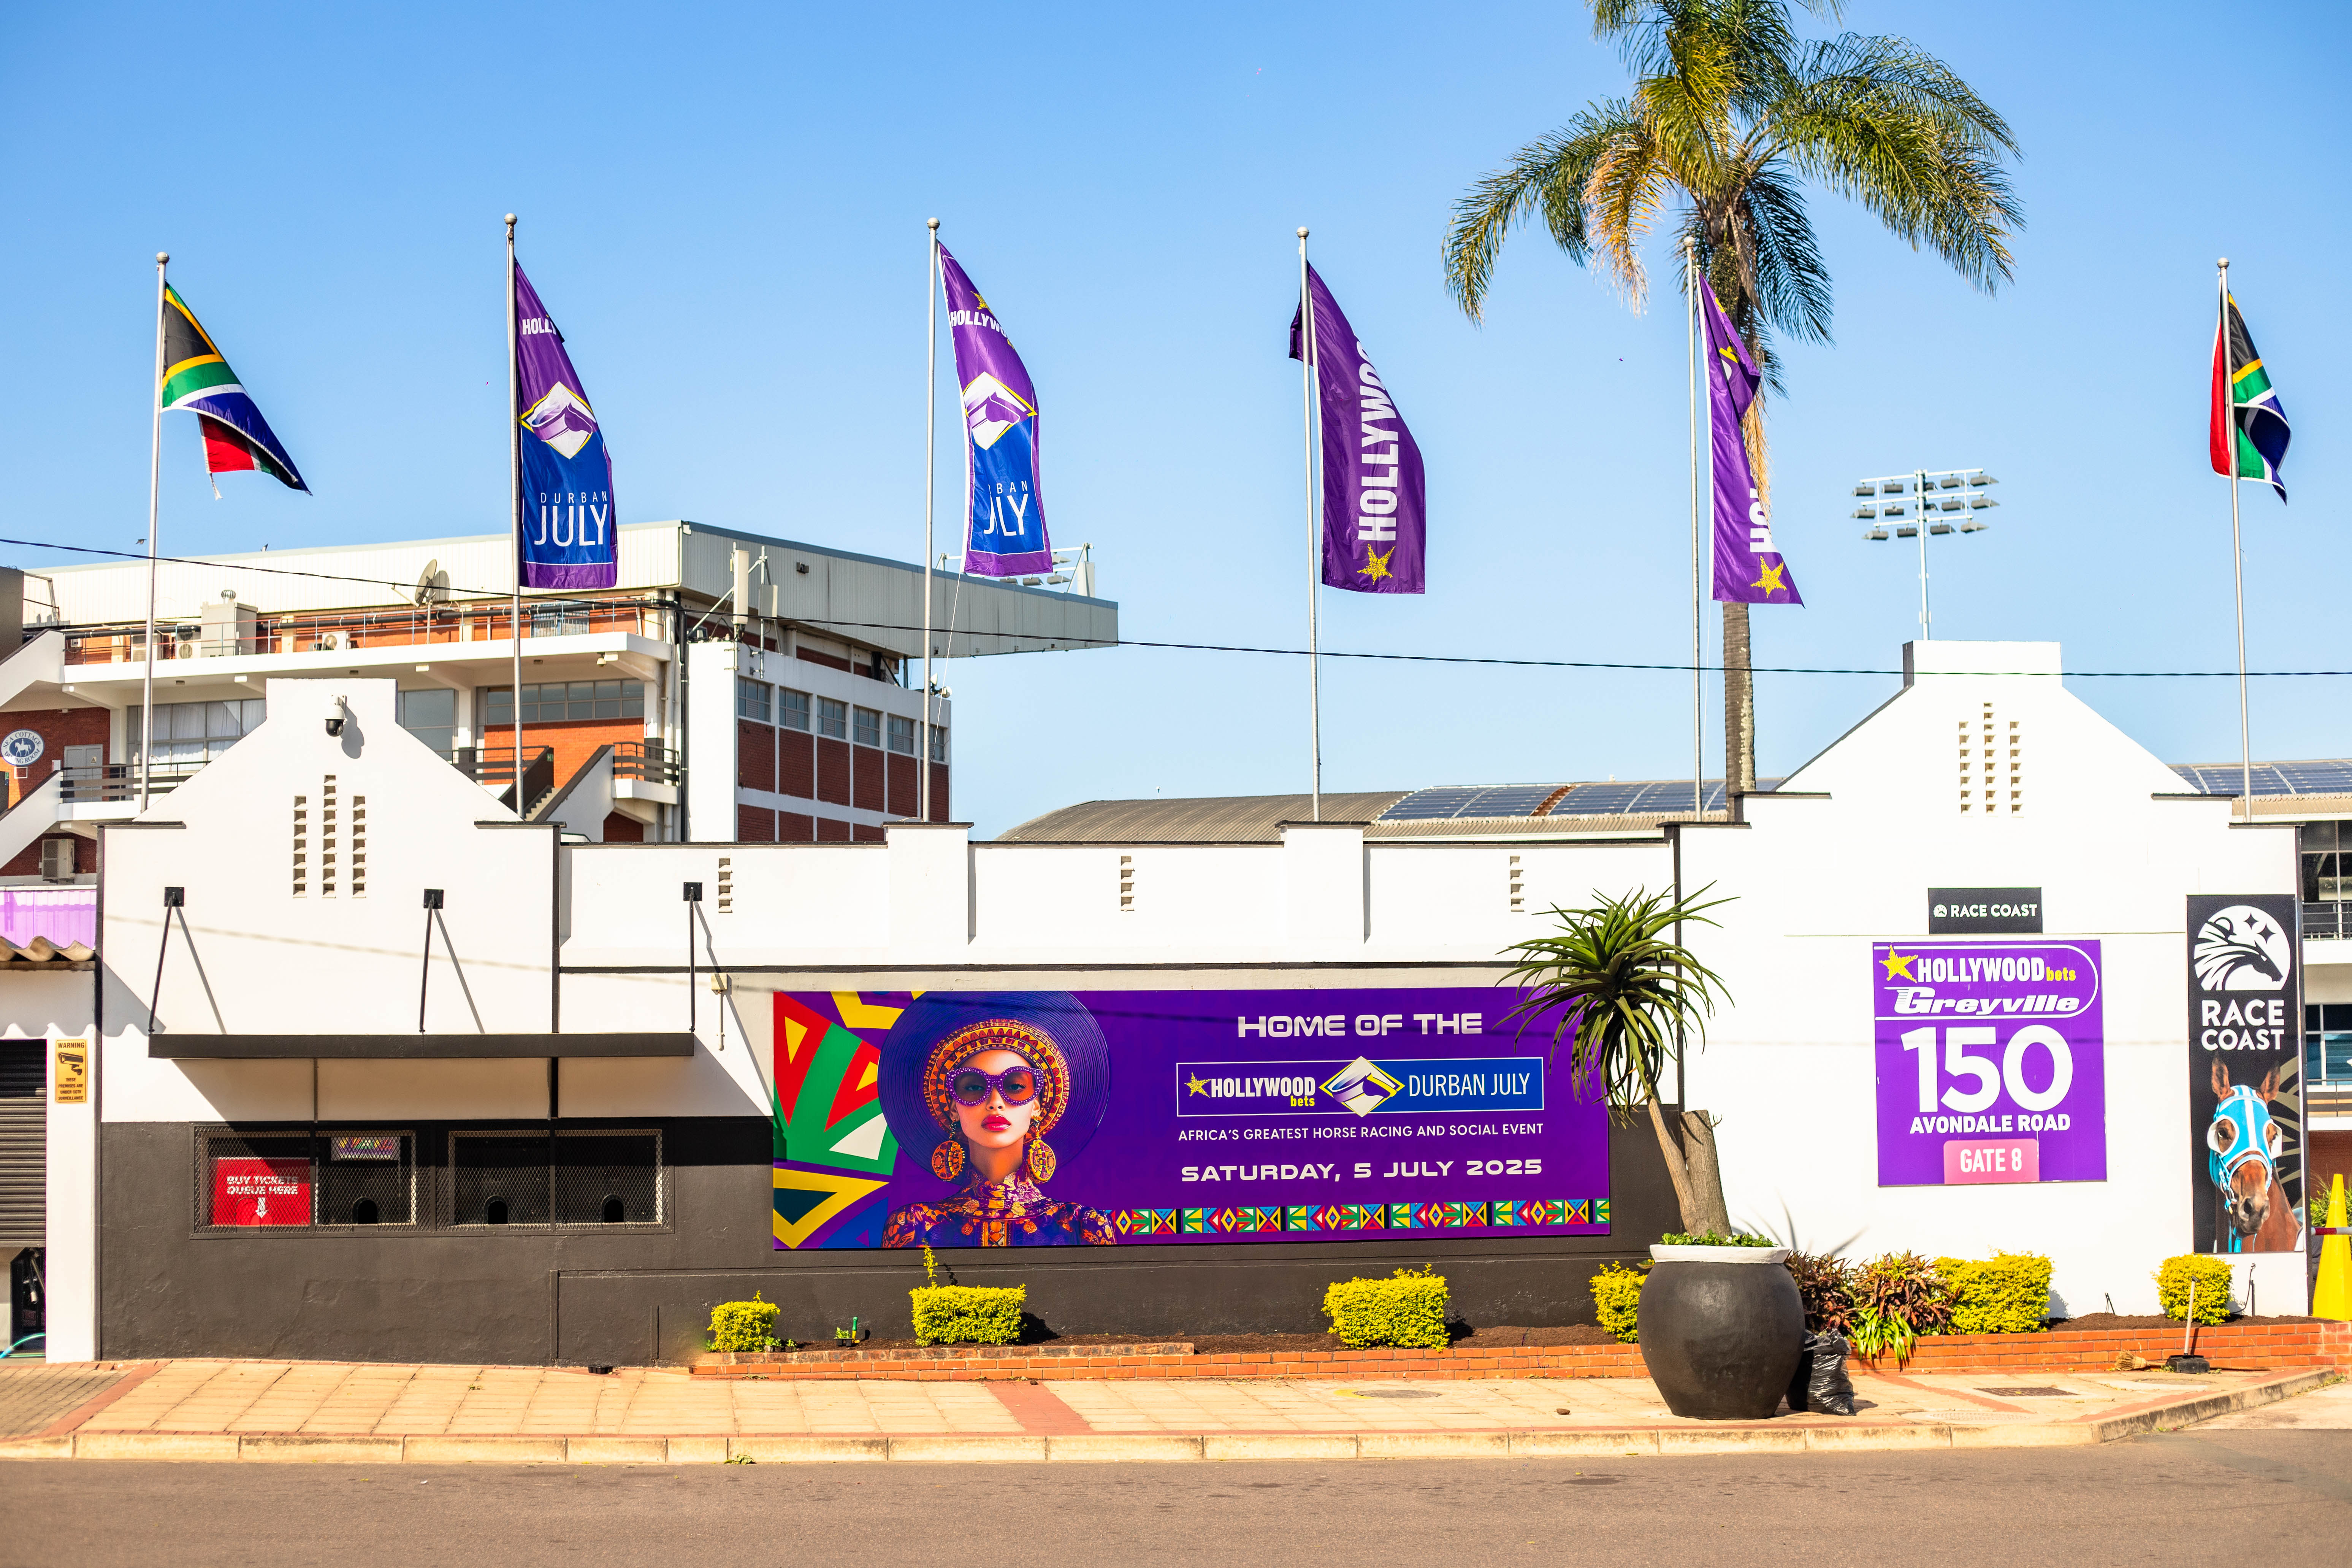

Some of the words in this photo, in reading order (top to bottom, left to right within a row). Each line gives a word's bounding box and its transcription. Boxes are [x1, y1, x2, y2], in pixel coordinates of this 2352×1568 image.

[540, 491, 607, 504] DURBAN
[983, 493, 1029, 536] JLY
[534, 504, 608, 547] JULY
[3, 737, 14, 748] SEA
[15, 732, 42, 747] COTTAGE
[24, 748, 40, 763] ROOM
[1951, 904, 1987, 917] RACE
[1991, 904, 2037, 917] COAST
[1884, 986, 2080, 1015] Greyville
[2202, 999, 2284, 1026] RACE
[1238, 1015, 1345, 1037] HOME
[1355, 1014, 1403, 1036] OF
[1413, 1013, 1482, 1035] THE
[2201, 1029, 2284, 1051] COAST
[1900, 1025, 2073, 1113] 150
[1211, 1077, 1315, 1097] HOLLYWOOD
[1409, 1074, 1485, 1097] DURBAN
[1491, 1073, 1530, 1095] JULY
[1290, 1095, 1315, 1107] bets
[1178, 1129, 1239, 1141] AFRICA'S
[1244, 1128, 1309, 1140] GREATEST
[1313, 1127, 1357, 1138] HORSE
[1361, 1126, 1412, 1137] RACING
[1417, 1126, 1445, 1136] AND
[1450, 1124, 1498, 1135] SOCIAL
[1503, 1123, 1543, 1134] EVENT
[1910, 1115, 2013, 1134] AVONDALE
[2018, 1114, 2070, 1132] ROAD
[1181, 1164, 1340, 1182] SATURDAY,
[1354, 1163, 1371, 1178] 5
[1384, 1161, 1454, 1177] JULY
[1467, 1159, 1542, 1175] 2025
[1960, 1148, 2006, 1173] GATE
[2011, 1148, 2022, 1171] 8
[227, 1176, 251, 1185] BUY
[253, 1176, 298, 1185] TICKETS
[227, 1186, 266, 1195] QUEUE
[268, 1186, 298, 1195] HERE
